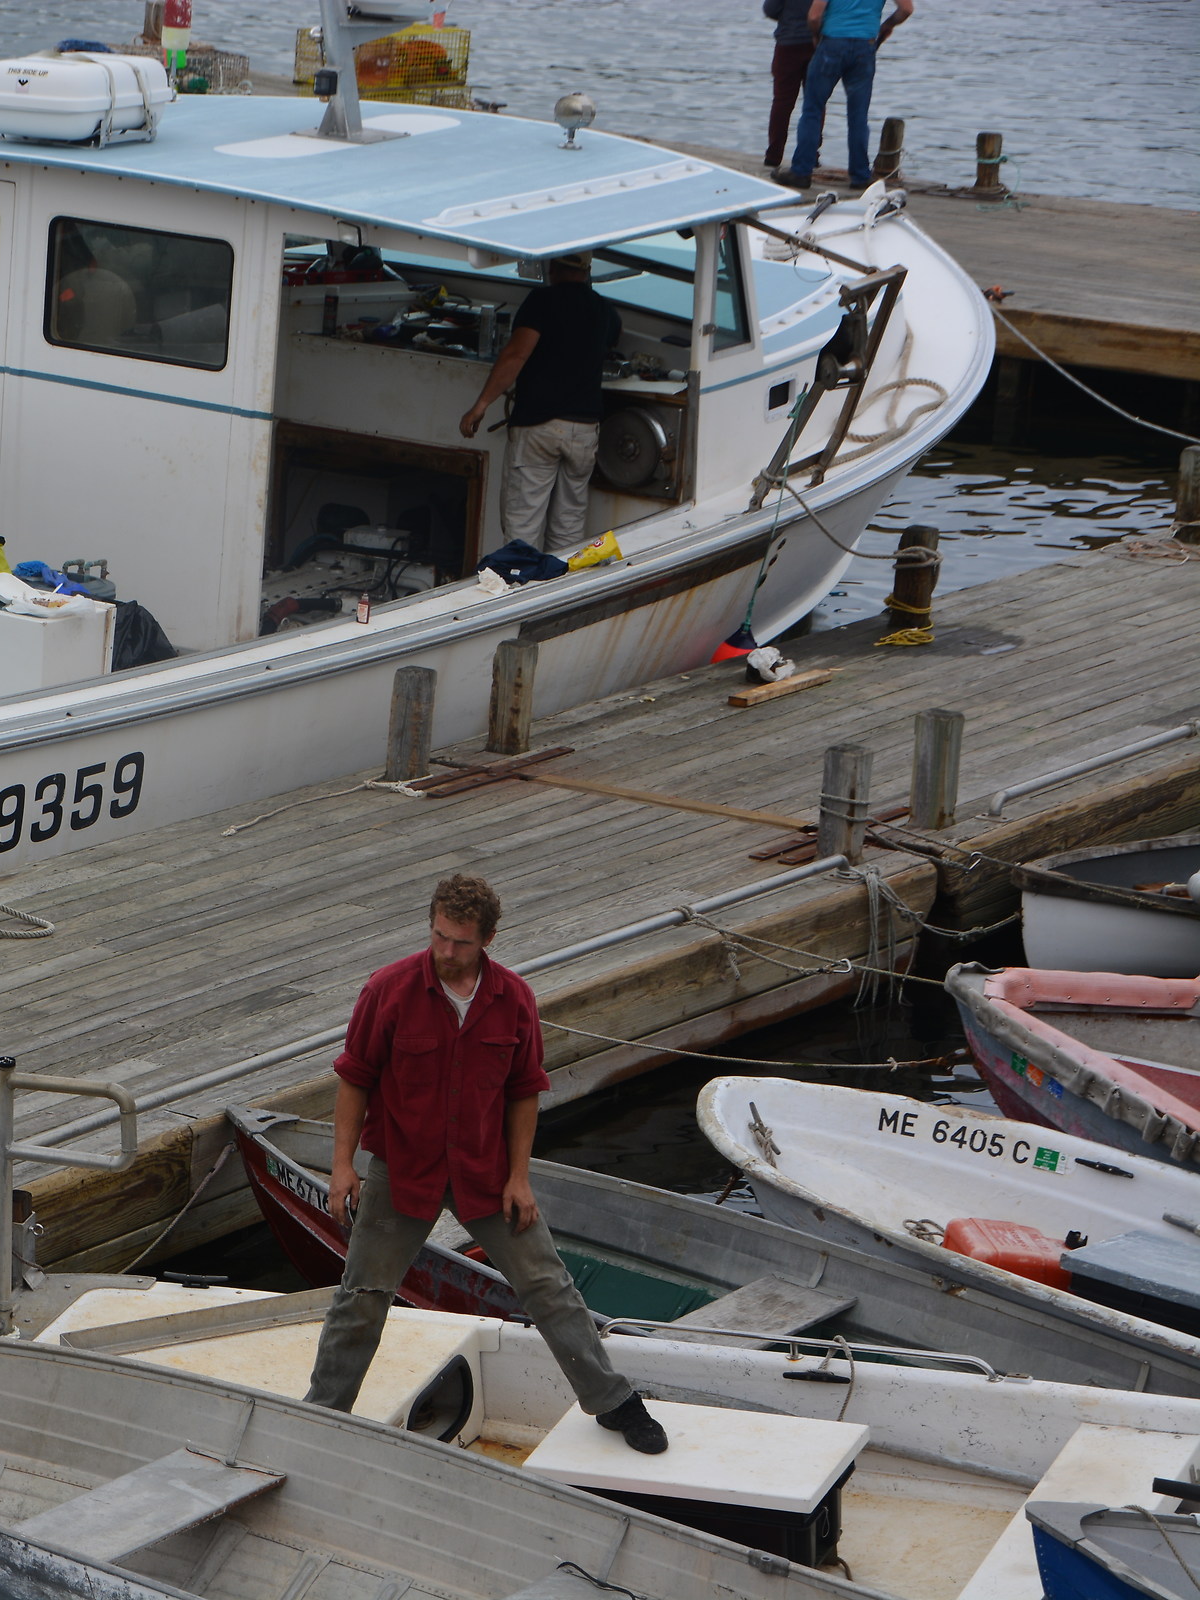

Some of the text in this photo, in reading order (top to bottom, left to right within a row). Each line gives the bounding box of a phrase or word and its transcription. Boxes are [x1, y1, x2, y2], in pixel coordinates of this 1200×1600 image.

[877, 1107, 916, 1137] ME
[932, 1120, 1006, 1157] 6405
[1012, 1140, 1031, 1164] C
